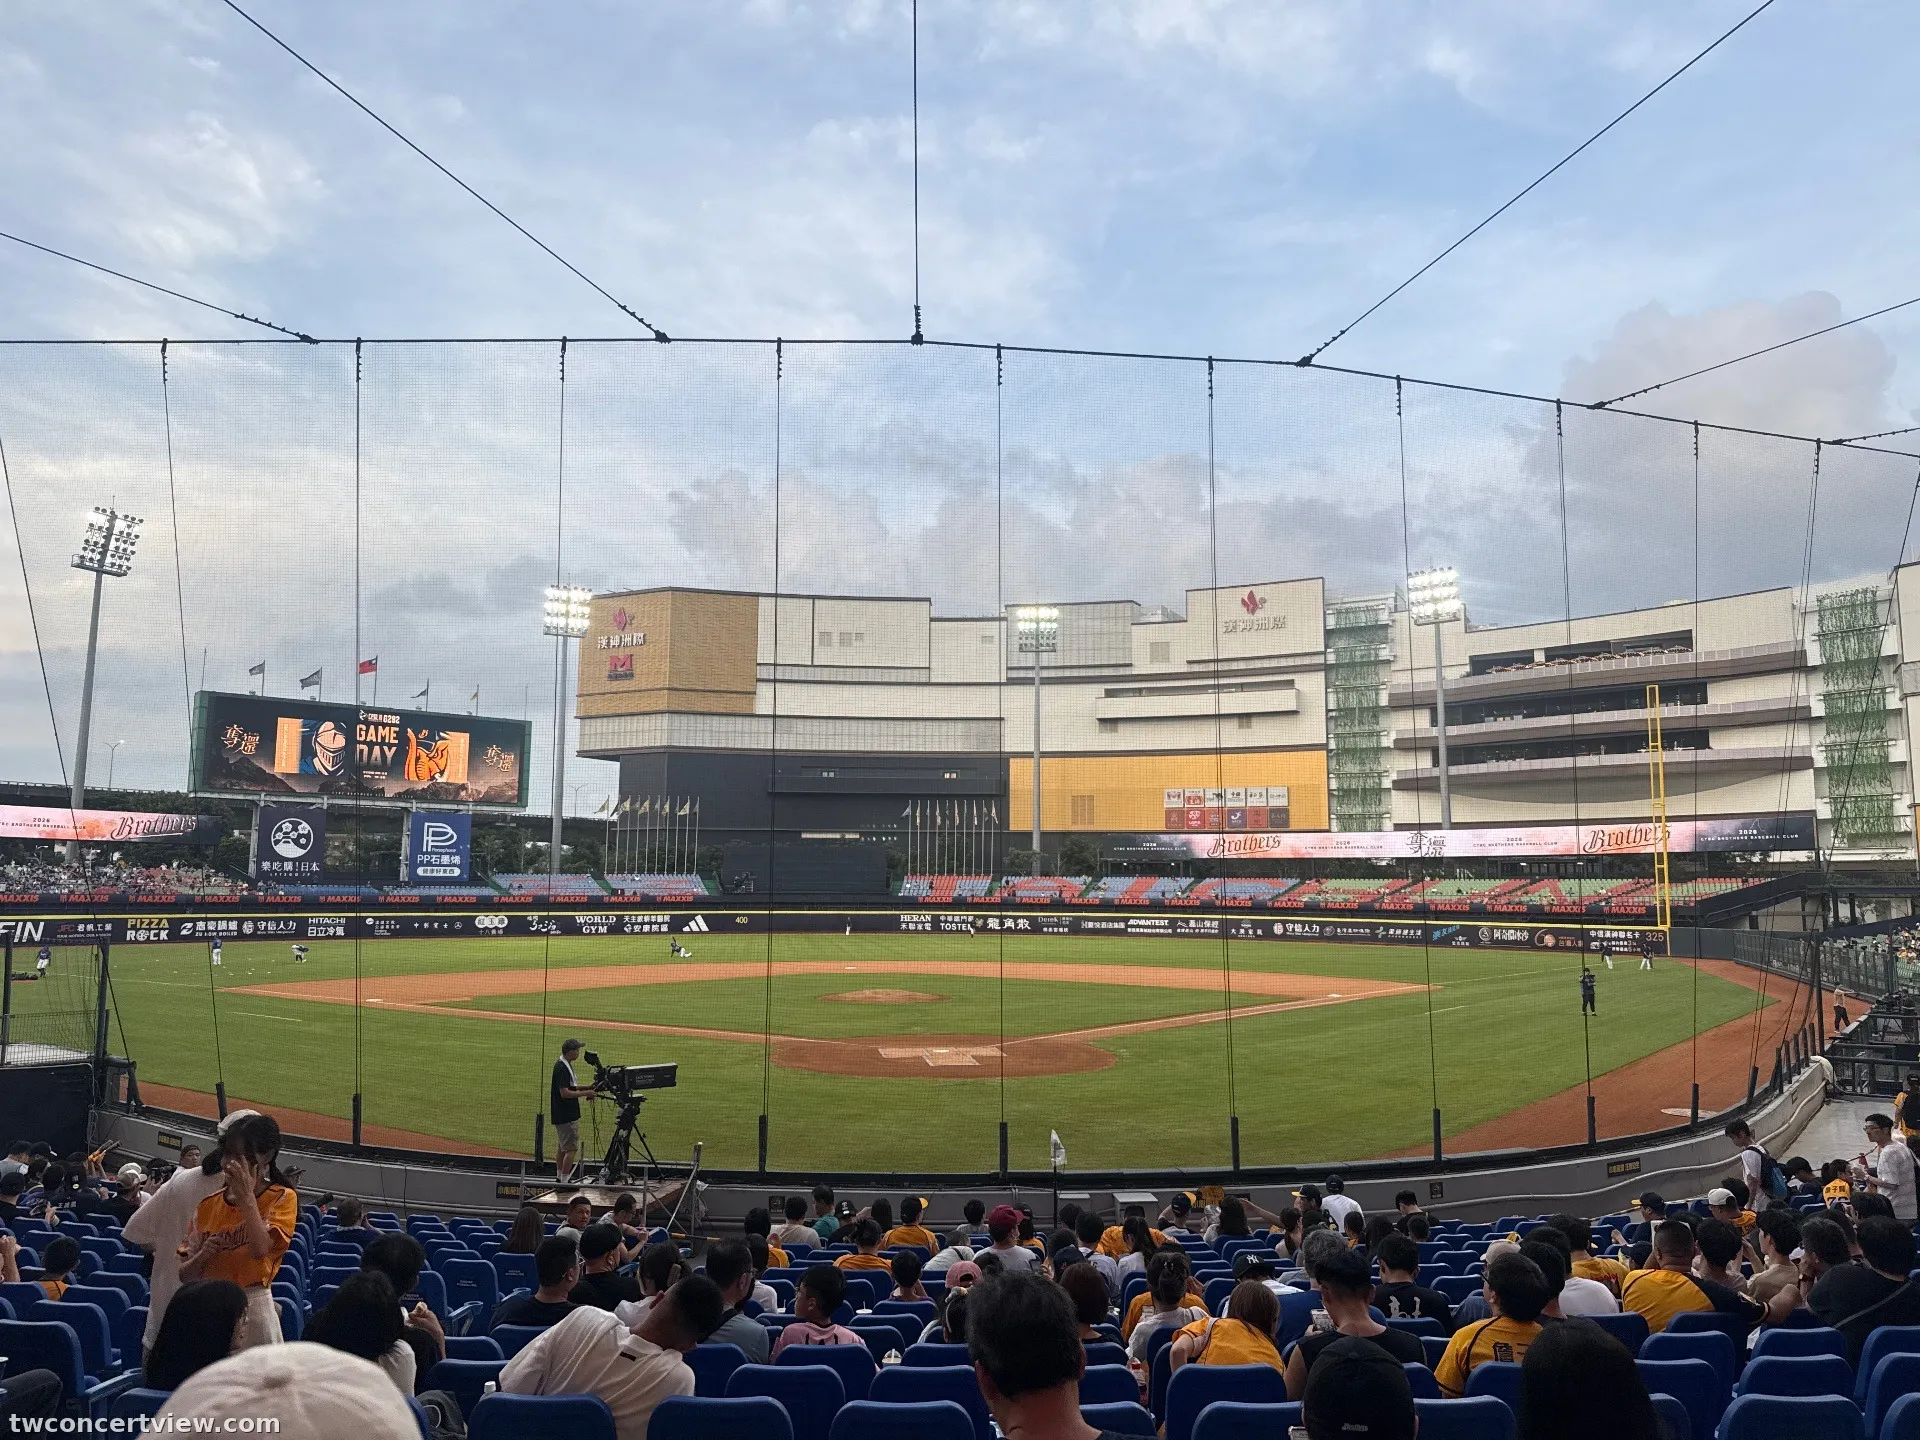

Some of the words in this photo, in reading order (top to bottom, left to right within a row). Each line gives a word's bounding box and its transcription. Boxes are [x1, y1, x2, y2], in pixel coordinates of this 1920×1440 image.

[1222, 614, 1286, 634] 漢神洲際
[597, 632, 646, 650] 漢神洲際
[356, 724, 399, 744] GAME
[355, 744, 398, 769] DAY
[110, 814, 197, 840] Brothers
[1207, 834, 1282, 858] Brothers
[417, 854, 461, 866] PP石墨烯
[261, 861, 320, 872] 樂吃購!日本
[68, 894, 110, 903] MAXXIS
[137, 894, 176, 903] MAXXIS
[205, 895, 240, 903] MAXXIS
[266, 895, 302, 903] MAXXIS
[326, 895, 361, 903] MAXXIS
[385, 895, 420, 903] MAXXIS
[443, 895, 477, 903] MAXXIS
[500, 895, 533, 903] MAXXIS
[556, 895, 588, 903] MAXXIS
[609, 895, 641, 903] MAXXIS
[663, 895, 694, 903] MAXXIS
[1437, 903, 1470, 911] MAXXIS
[1493, 904, 1528, 912] MAXXIS
[1552, 905, 1586, 913] MAXXIS
[1611, 906, 1646, 914] MAXXIS
[308, 917, 346, 925] HITACHI
[575, 915, 617, 923] WORLD
[735, 916, 748, 924] 400
[900, 914, 932, 922] HERAN
[127, 918, 170, 928] PIZZA
[257, 920, 297, 930] 守信人力
[900, 923, 932, 931] 禾聯家電
[986, 917, 1031, 930] 龍角散
[308, 926, 345, 936] 日立冷氣
[582, 925, 608, 933] GYM
[633, 924, 669, 932] 安康院區
[1285, 922, 1320, 933] 守信人力
[126, 929, 169, 941] ROCK
[1589, 930, 1641, 939] 中信漢神聯名卡
[1645, 931, 1665, 942] 325
